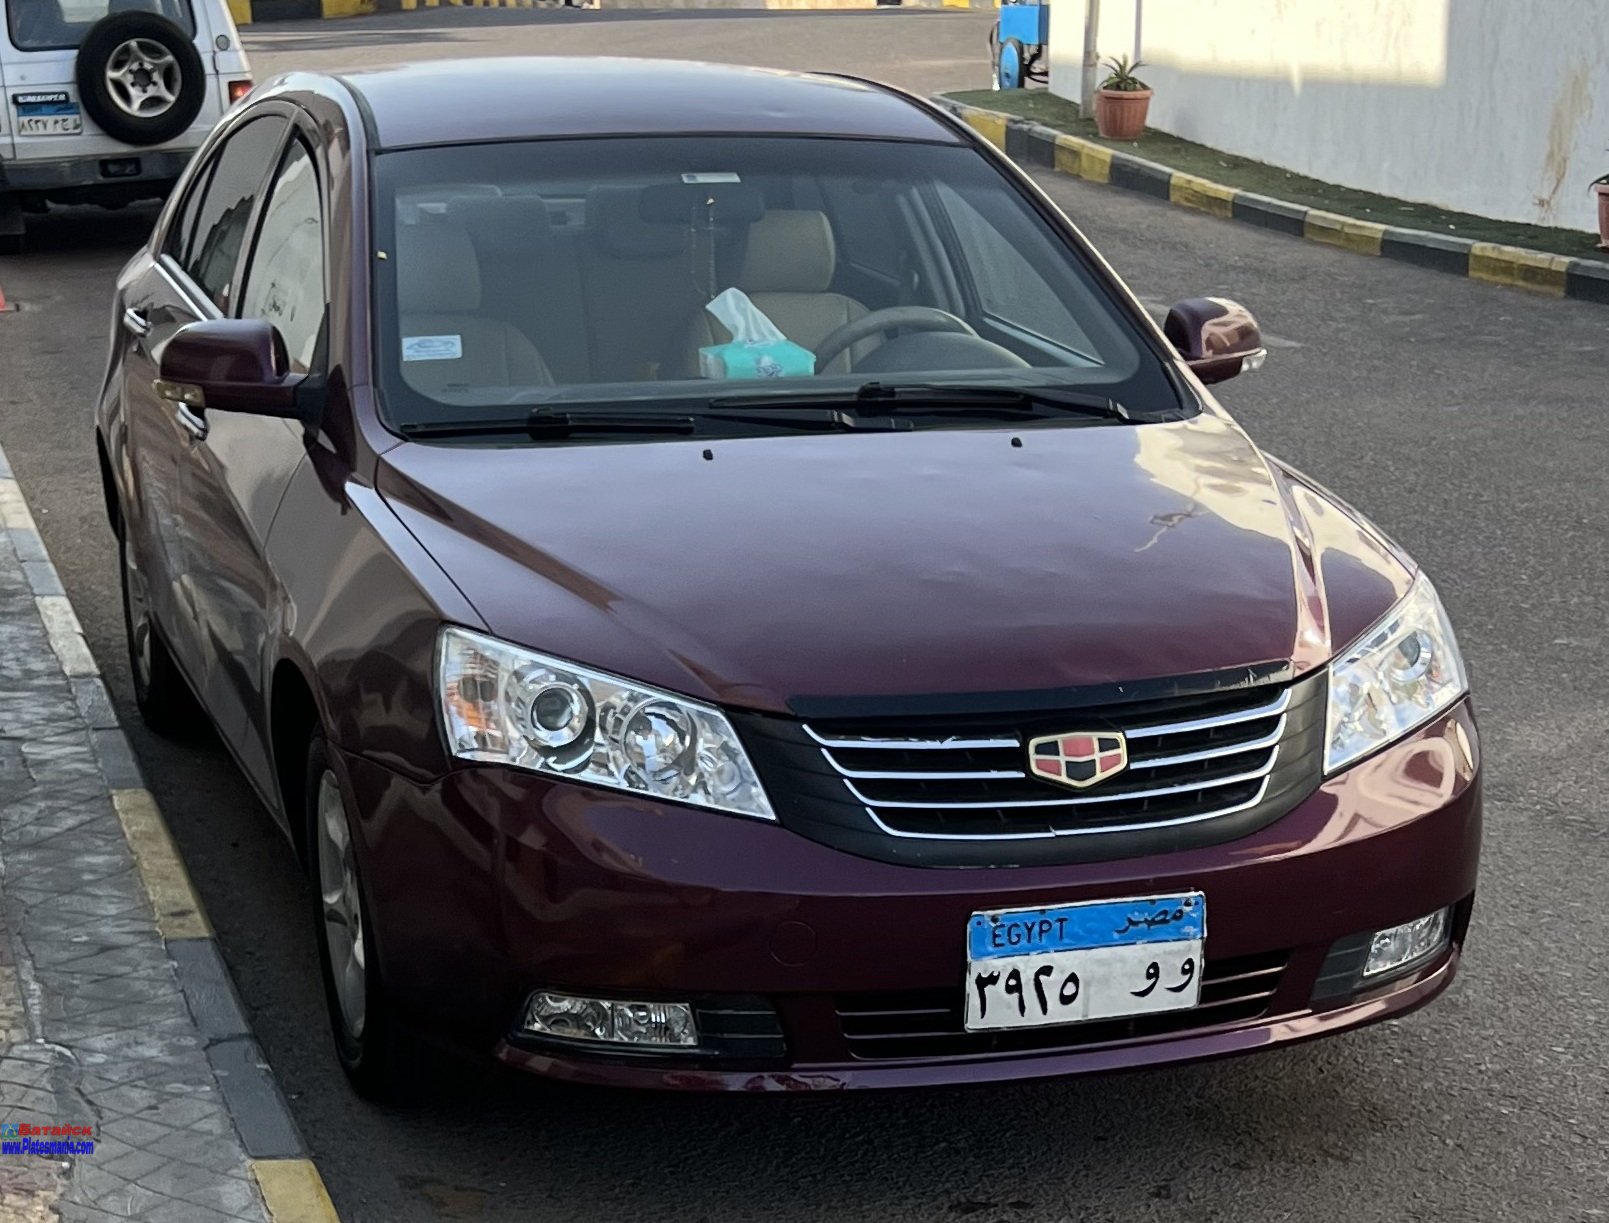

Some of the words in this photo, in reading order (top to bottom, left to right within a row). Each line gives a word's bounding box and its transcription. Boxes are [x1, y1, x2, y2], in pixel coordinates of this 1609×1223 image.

[992, 917, 1068, 947] EGYPT
[1115, 908, 1184, 934] مصر
[975, 965, 1080, 1019] ٣٩٢٥
